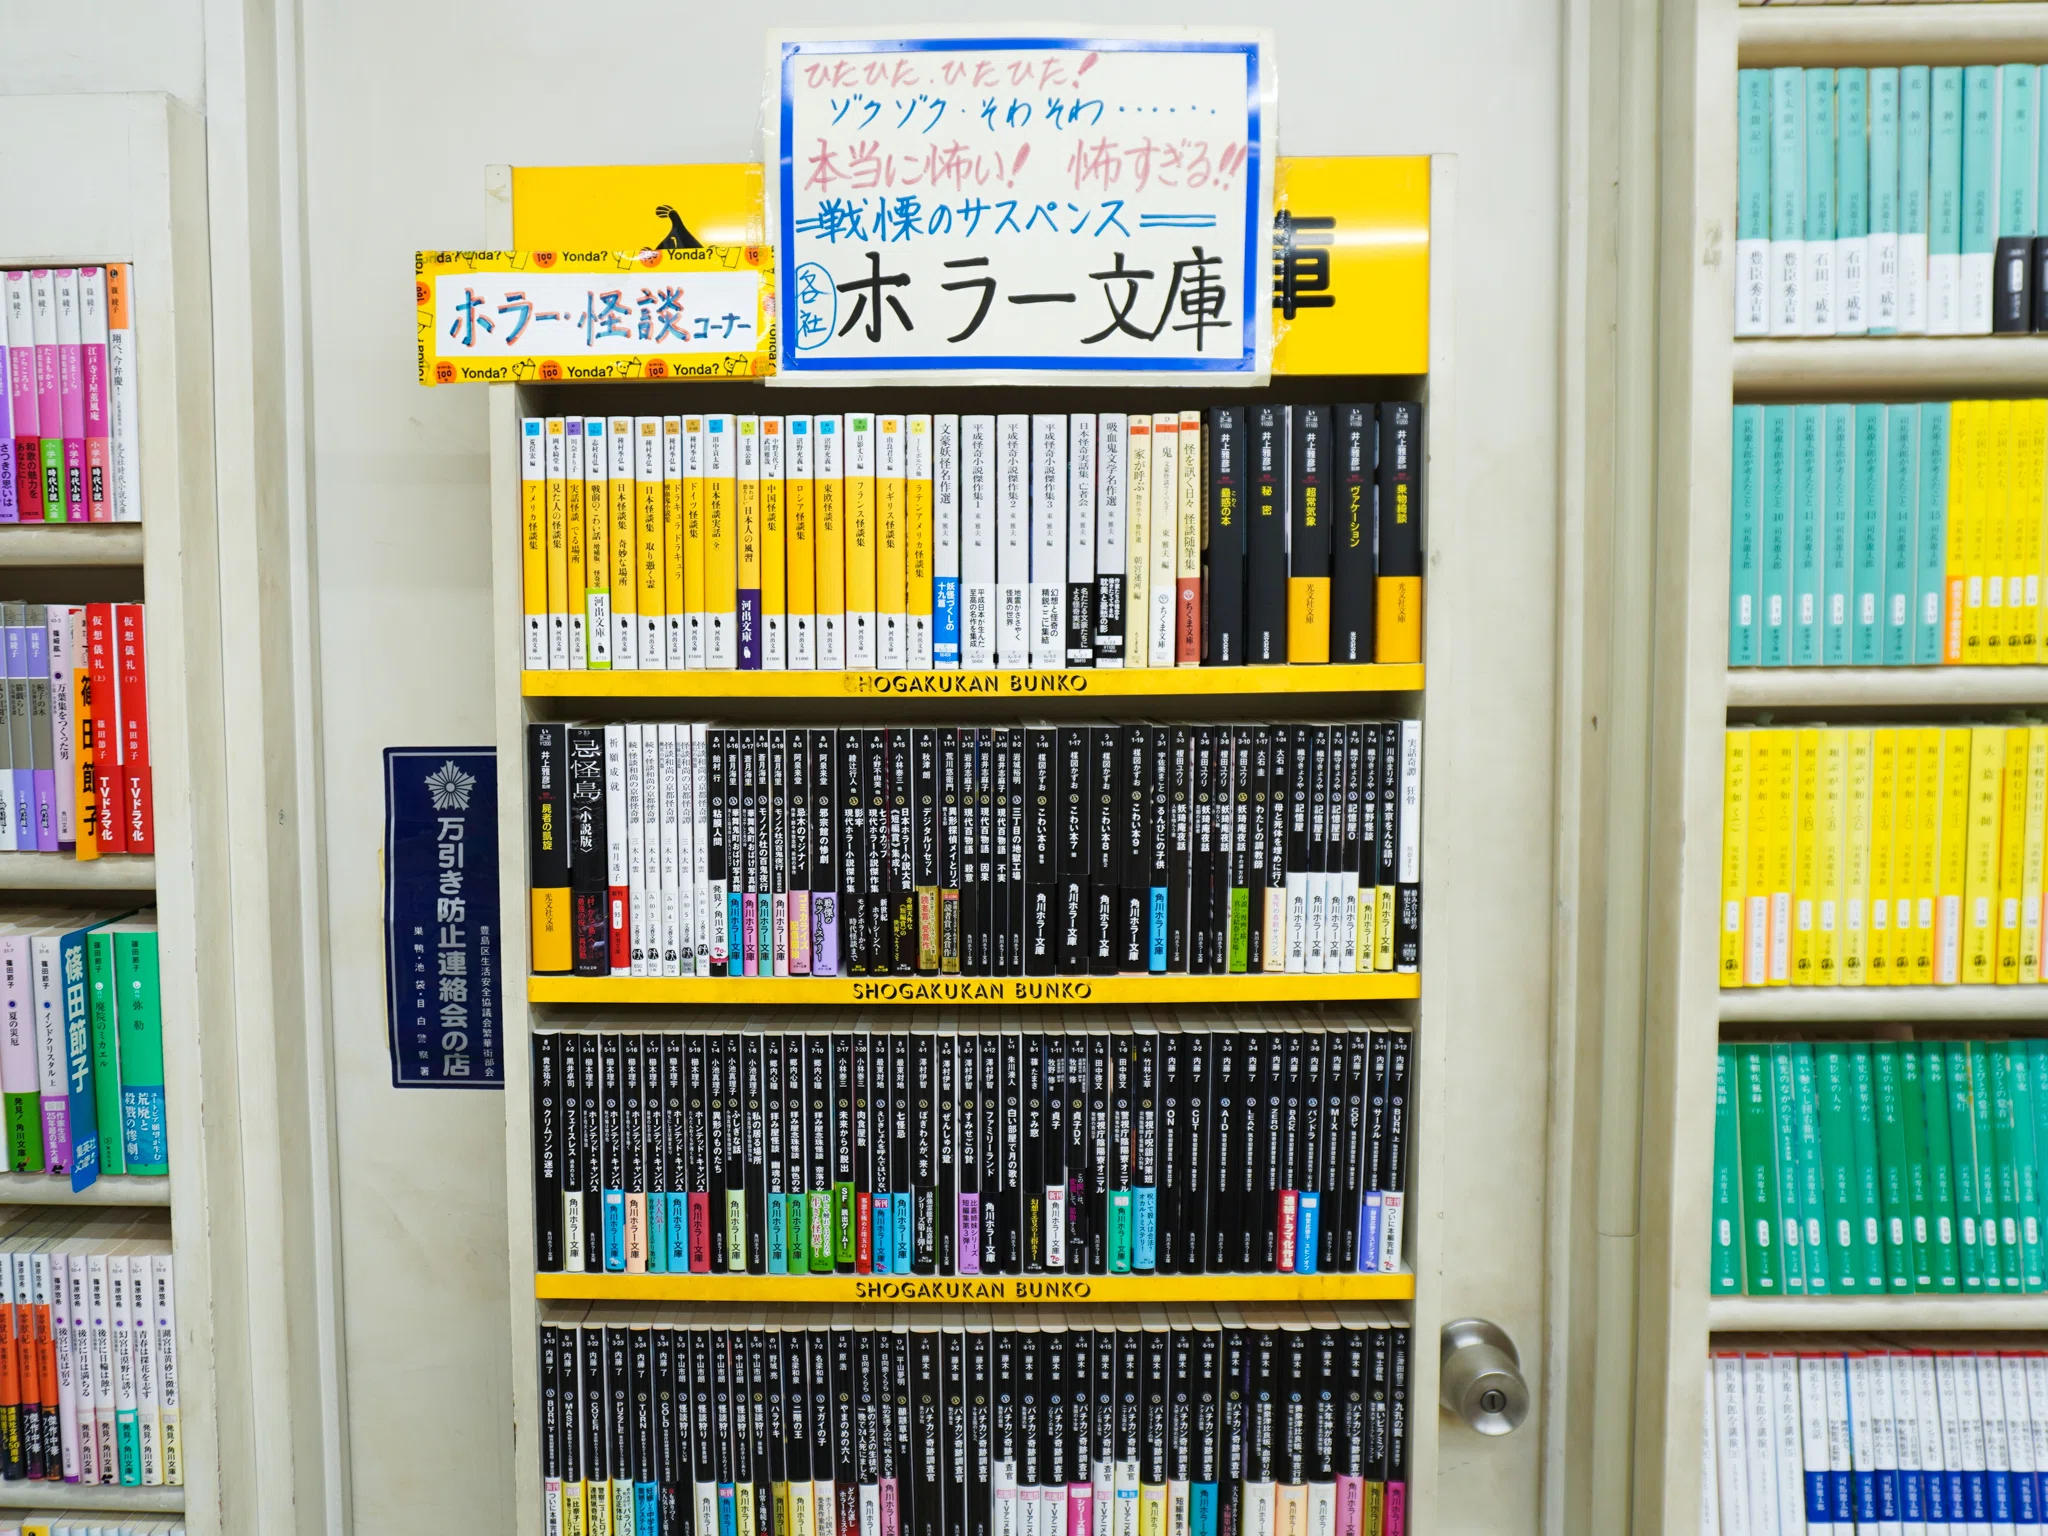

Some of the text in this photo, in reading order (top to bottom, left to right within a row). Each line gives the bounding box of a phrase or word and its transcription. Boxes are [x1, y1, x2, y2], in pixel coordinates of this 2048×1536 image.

[562, 249, 713, 262] Yonda? Yonda?
[798, 267, 827, 335] 各社
[836, 246, 1233, 351] ホラー文庫
[461, 364, 720, 379] Yonda? Yonda? Yonda?
[939, 423, 951, 504] 文豪妖怪名作選
[1078, 421, 1089, 507] 日本怪奇実話集 亡者会
[1106, 421, 1118, 507] 吸血鬼文学名作選
[1133, 448, 1146, 492] 家が呼ぶ
[1221, 433, 1231, 468] 井上雅彦
[528, 484, 538, 550] アメリカ怪談集
[551, 483, 562, 549] 見た人の怪談集
[569, 484, 581, 563] 実話怪談 でる場所
[591, 484, 601, 541] 戦前のこわい話
[616, 483, 628, 587] 日本怪談集 奇妙な場所
[645, 486, 655, 533] 日本怪談集
[673, 483, 683, 580] ドラキュラ ドラキュラ
[688, 482, 699, 539] ドイツ怪談集
[711, 482, 722, 538] 日本怪談実話
[744, 506, 754, 563] 日本人の風習
[767, 484, 777, 531] 中国怪談集
[795, 484, 806, 541] ロシア怪談集
[823, 484, 834, 531] 東欧怪談集
[856, 482, 866, 548] フランス怪談集
[886, 484, 895, 549] イギリス怪談集
[915, 484, 925, 579] ラテンアメリカ怪談集
[1183, 443, 1196, 571] 怪を訊く日々 怪談随筆集
[1305, 486, 1317, 527] 超常気象
[1350, 485, 1361, 548] ヴァケーション
[593, 595, 606, 638] 河出文庫
[741, 600, 753, 643] 河出文庫
[969, 588, 978, 649] 至高の名作を集成
[977, 588, 986, 649] 平成日本が生んだ
[1006, 588, 1014, 626] 怪異の世界
[1013, 588, 1022, 642] 地霊がささやく
[1041, 588, 1050, 644] 精鋭ここに集結
[1050, 588, 1059, 637] 幻想と怪奇の
[1158, 605, 1167, 649] ちくま文庫
[1185, 601, 1194, 645] ちくま文庫
[1305, 583, 1315, 624] 光文社文庫
[92, 616, 105, 670] 仮想儀礼
[124, 616, 136, 670] 仮想儀礼
[1010, 674, 1087, 692] BUNKO
[57, 684, 70, 760] 万葉集をつくった男
[97, 720, 107, 760] 篠田節子
[129, 720, 139, 760] 篠田節子
[570, 740, 603, 801] 忌怪島
[99, 777, 113, 841] TVドラマ化
[130, 777, 145, 842] TVドラマ化
[542, 804, 553, 851] 屍者の凱旋
[712, 809, 723, 847] 粘膜人間
[819, 808, 829, 864] 邪宗館の惨劇
[879, 808, 888, 859] 七つのカップ
[964, 808, 974, 855] 現代百物語
[1294, 803, 1305, 832] 記憶屋
[1383, 803, 1394, 868] 東京をんな語り
[844, 809, 856, 893] 現代ホラー小説傑作集
[901, 808, 912, 890] 日本ホラー小説大賞
[922, 808, 933, 876] デジタルリセット
[948, 807, 958, 888] 異形探偵メイとリズ
[1012, 807, 1022, 881] 三丁目の地獄工場
[1155, 807, 1166, 870] るんびにの子供
[1254, 806, 1264, 870] わたしの調教師
[1272, 803, 1284, 888] 母と死体を埋めに行く
[980, 863, 990, 882] 因果
[544, 893, 554, 932] 光文社文庫
[730, 898, 740, 961] 角川ホラー文庫
[759, 899, 770, 961] 角川ホラー文庫
[879, 898, 888, 922] 新世紀
[1034, 893, 1047, 956] 角川ホラー文庫
[436, 816, 471, 1078] 万引き防止連絡会の店
[64, 944, 90, 1094] 篠田節子
[852, 982, 1092, 1000] SHOGAKUKAN BUNKO
[8, 1011, 19, 1047] 夏の災厄
[44, 1013, 57, 1077] インドクリスタル
[95, 1001, 109, 1068] 廃院のミカエル
[542, 1057, 551, 1087] 貴志祐介
[137, 1091, 150, 1131] 荒廃と
[567, 1110, 577, 1157] フェイスレス
[732, 1110, 741, 1155] ふしぎな話
[752, 1111, 762, 1165] 私の居る場所
[770, 1112, 780, 1153] 拝み屋怪談
[856, 1110, 866, 1147] 肉食屋敷
[896, 1111, 906, 1139] 七怪忌
[1029, 1111, 1039, 1138] やみ窓
[1072, 1111, 1082, 1146] 貞子DX
[1307, 1109, 1318, 1141] パンドラ
[1371, 1108, 1382, 1140] サークル
[543, 1109, 554, 1178] クリムゾンの迷宮
[712, 1111, 723, 1174] 異形のものたち
[839, 1110, 849, 1174] 未来からの脱出
[919, 1110, 928, 1178] ぼぎわんが、来る
[985, 1111, 995, 1177] ファミリーランド
[1007, 1109, 1017, 1188] 白い部屋で月の歌を
[970, 1200, 978, 1257] 比嘉姉妹シリーズ
[1282, 1196, 1294, 1268] 連続ドラマ化作品
[855, 1281, 1092, 1299] SHOGAKUKAN BUNKO
[58, 1327, 71, 1387] 後宮に星は宿る
[78, 1328, 91, 1398] 後宮に月は満ちる
[138, 1330, 152, 1400] 青春は探花を志す
[698, 1404, 708, 1440] 怪談狩り
[792, 1405, 803, 1439] 二階の王
[817, 1405, 827, 1447] マガイの子
[840, 1405, 850, 1464] やまのめの六人
[925, 1405, 935, 1483] バチカン奇跡調査官
[1375, 1403, 1386, 1460] 黒いピラミッド
